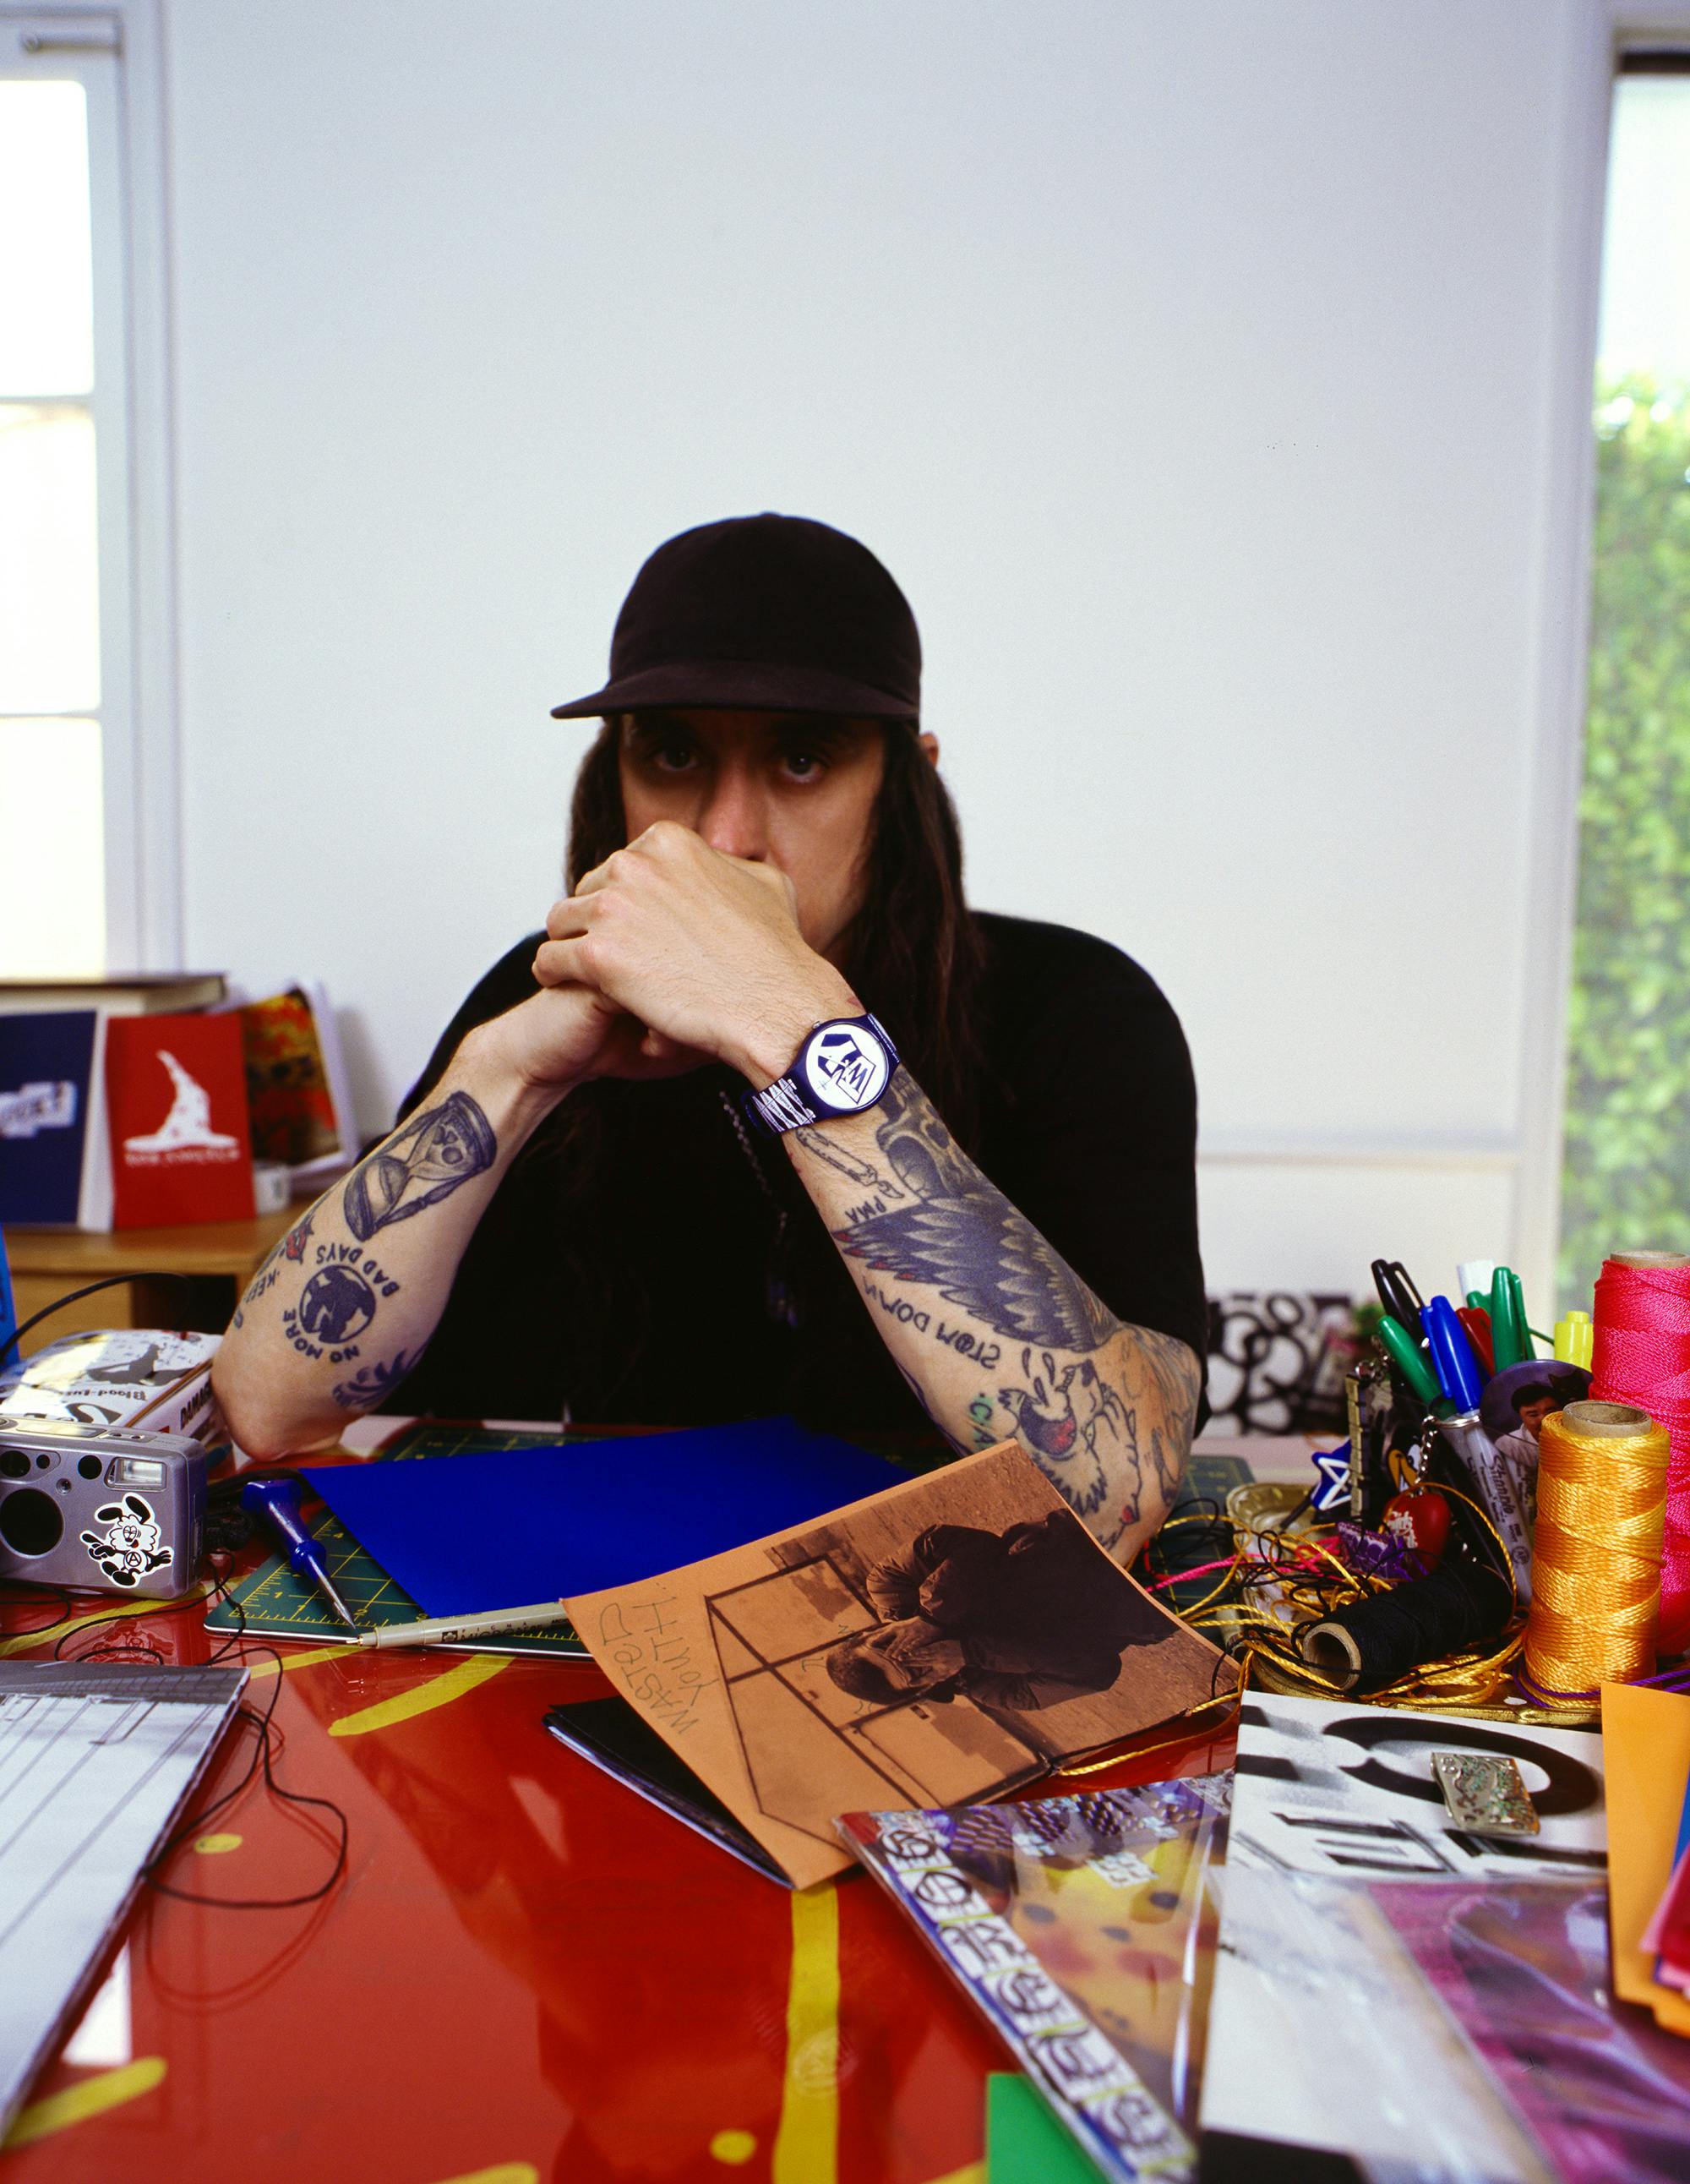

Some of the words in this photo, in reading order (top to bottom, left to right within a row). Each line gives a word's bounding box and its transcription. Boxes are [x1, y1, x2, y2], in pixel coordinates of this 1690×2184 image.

[845, 1195, 886, 1223] PMA
[316, 1242, 363, 1264] DAYS
[363, 1260, 400, 1297] BAD
[283, 1309, 324, 1359] MORE
[330, 1346, 360, 1362] NO
